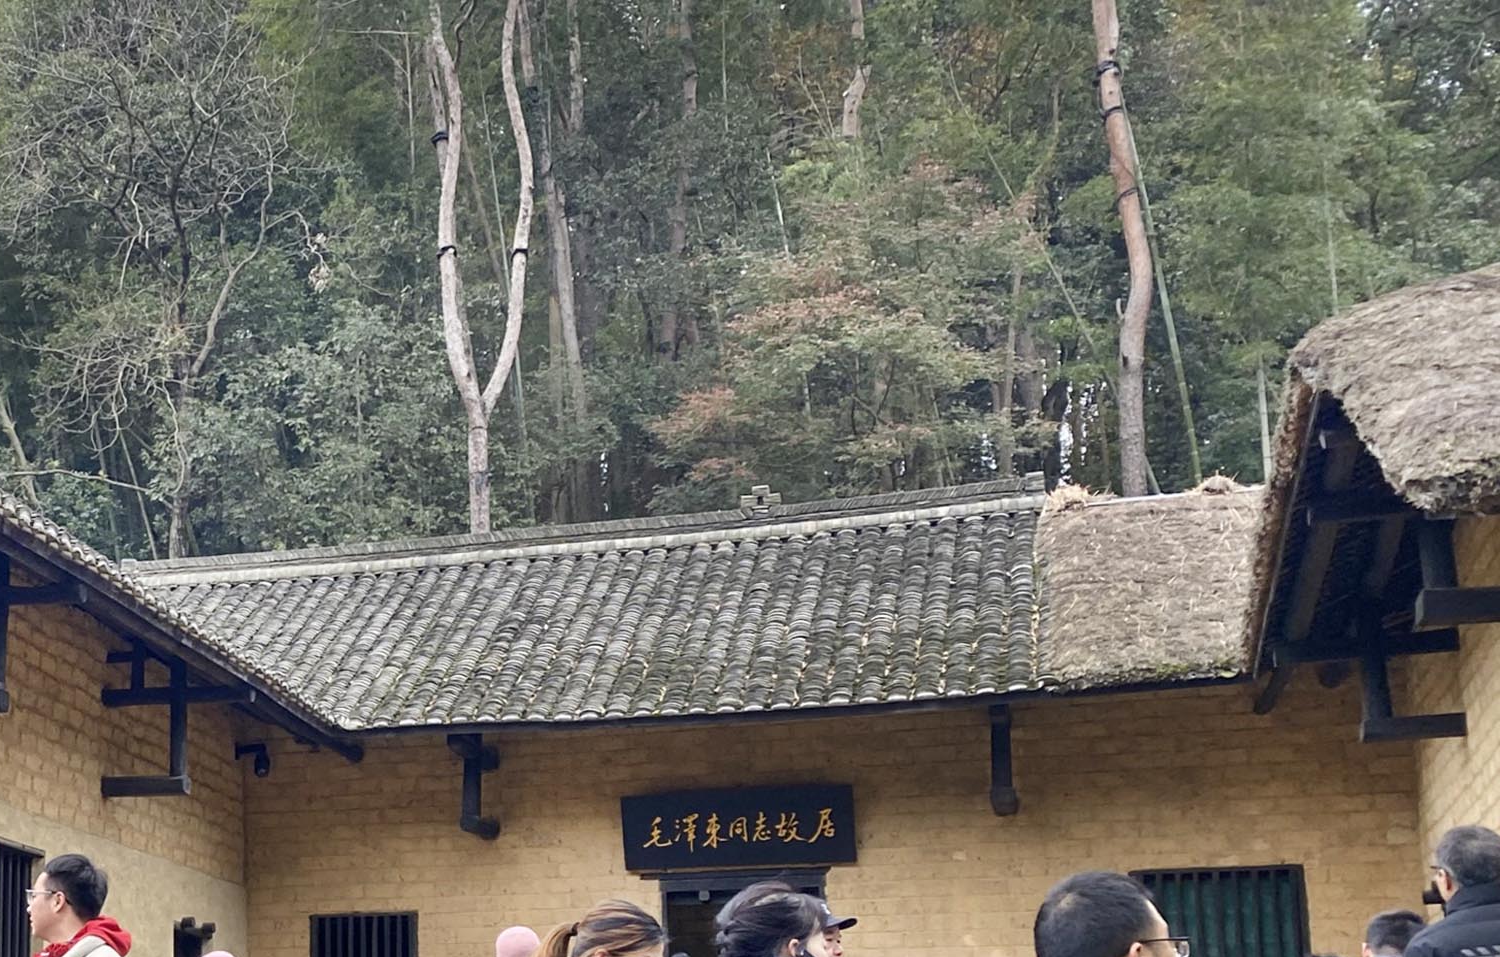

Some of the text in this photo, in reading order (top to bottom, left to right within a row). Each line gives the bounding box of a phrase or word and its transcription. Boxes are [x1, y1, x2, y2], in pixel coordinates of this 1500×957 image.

[642, 808, 836, 852] 毛澤東同志故居
